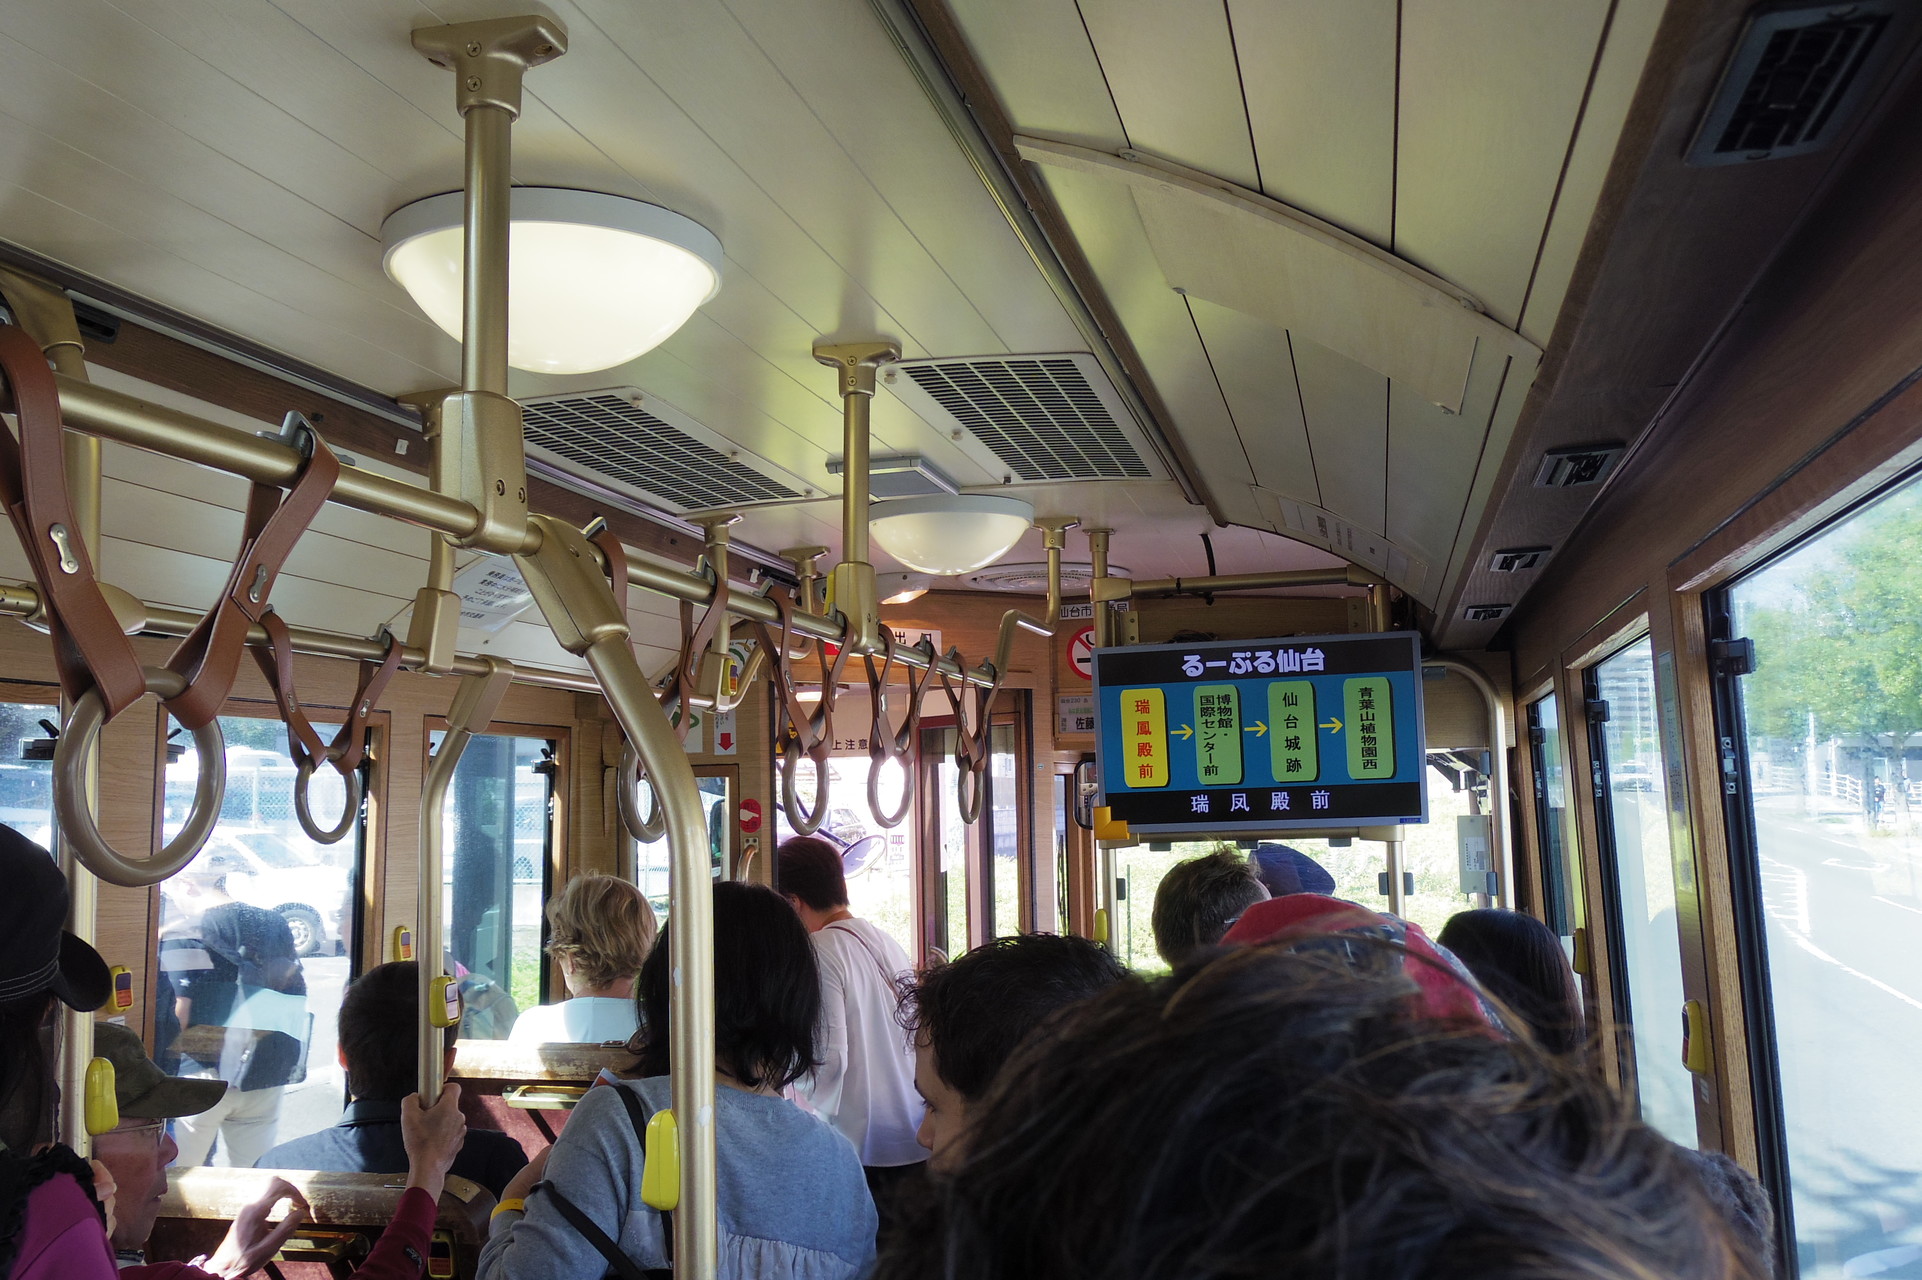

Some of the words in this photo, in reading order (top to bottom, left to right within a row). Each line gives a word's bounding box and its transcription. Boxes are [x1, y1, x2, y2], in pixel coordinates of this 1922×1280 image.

[1181, 647, 1325, 677] るーぷる仙台
[832, 739, 869, 751] 上注意
[1134, 698, 1153, 779] 瑞鳳殿前
[1199, 694, 1219, 776] 国際センター前
[1282, 691, 1302, 773] 仙台城跡
[1358, 686, 1378, 770] 青葉山植物園西
